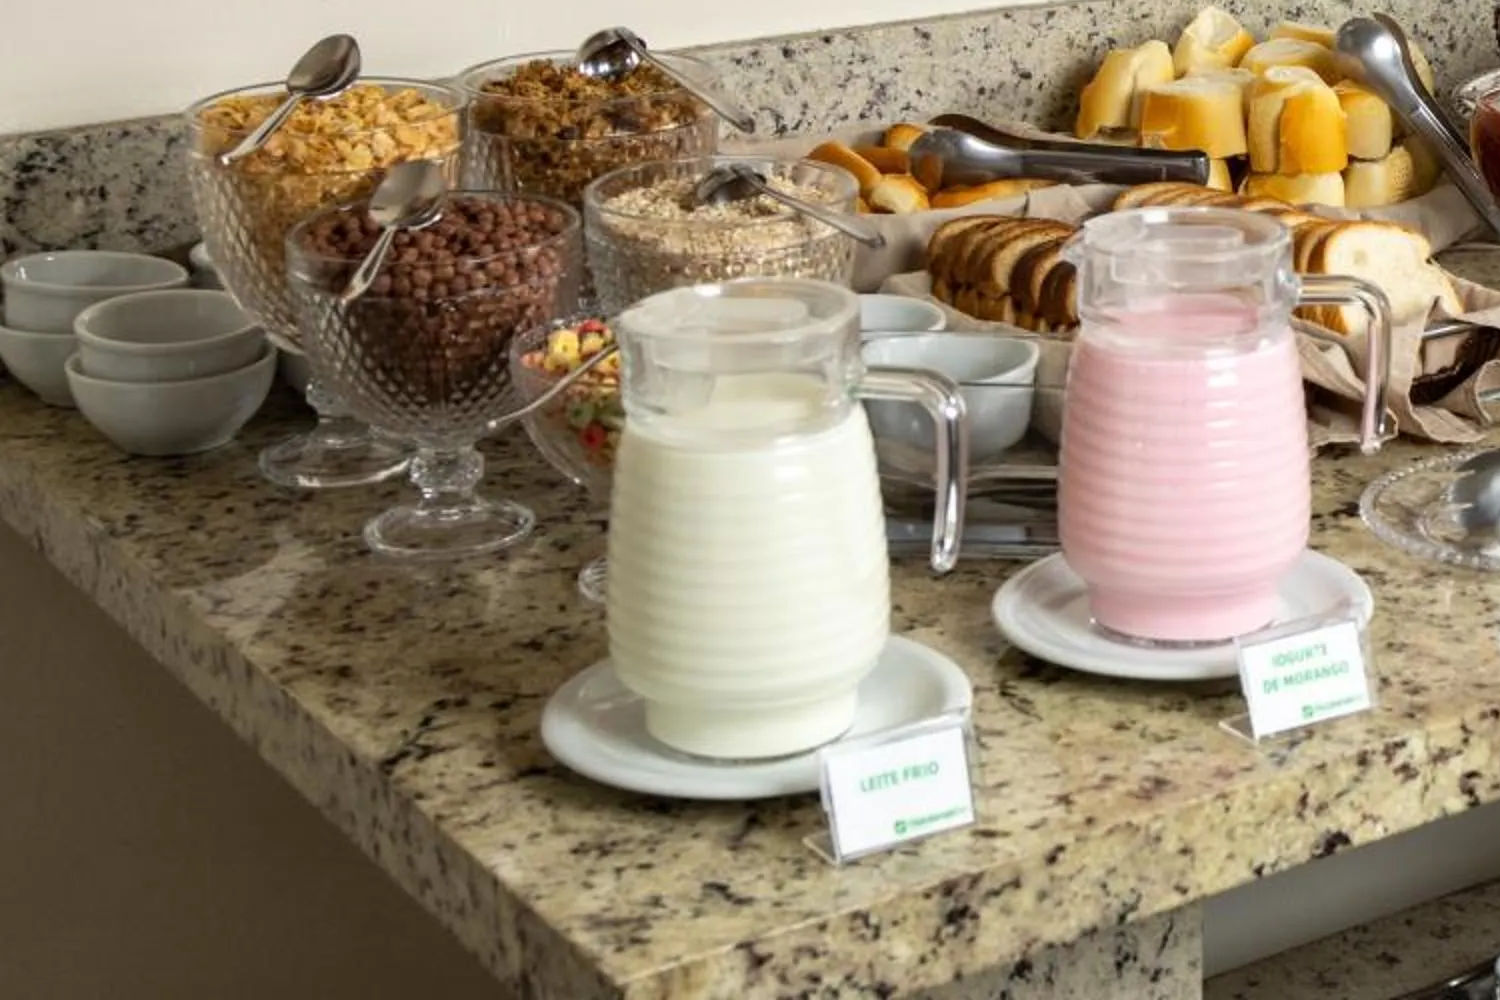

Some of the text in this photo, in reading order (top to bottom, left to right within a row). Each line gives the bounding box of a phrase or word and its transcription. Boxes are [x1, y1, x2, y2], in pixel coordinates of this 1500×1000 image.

[1263, 660, 1349, 694] DE MORANGO
[860, 761, 939, 792] LEITE FRIO
